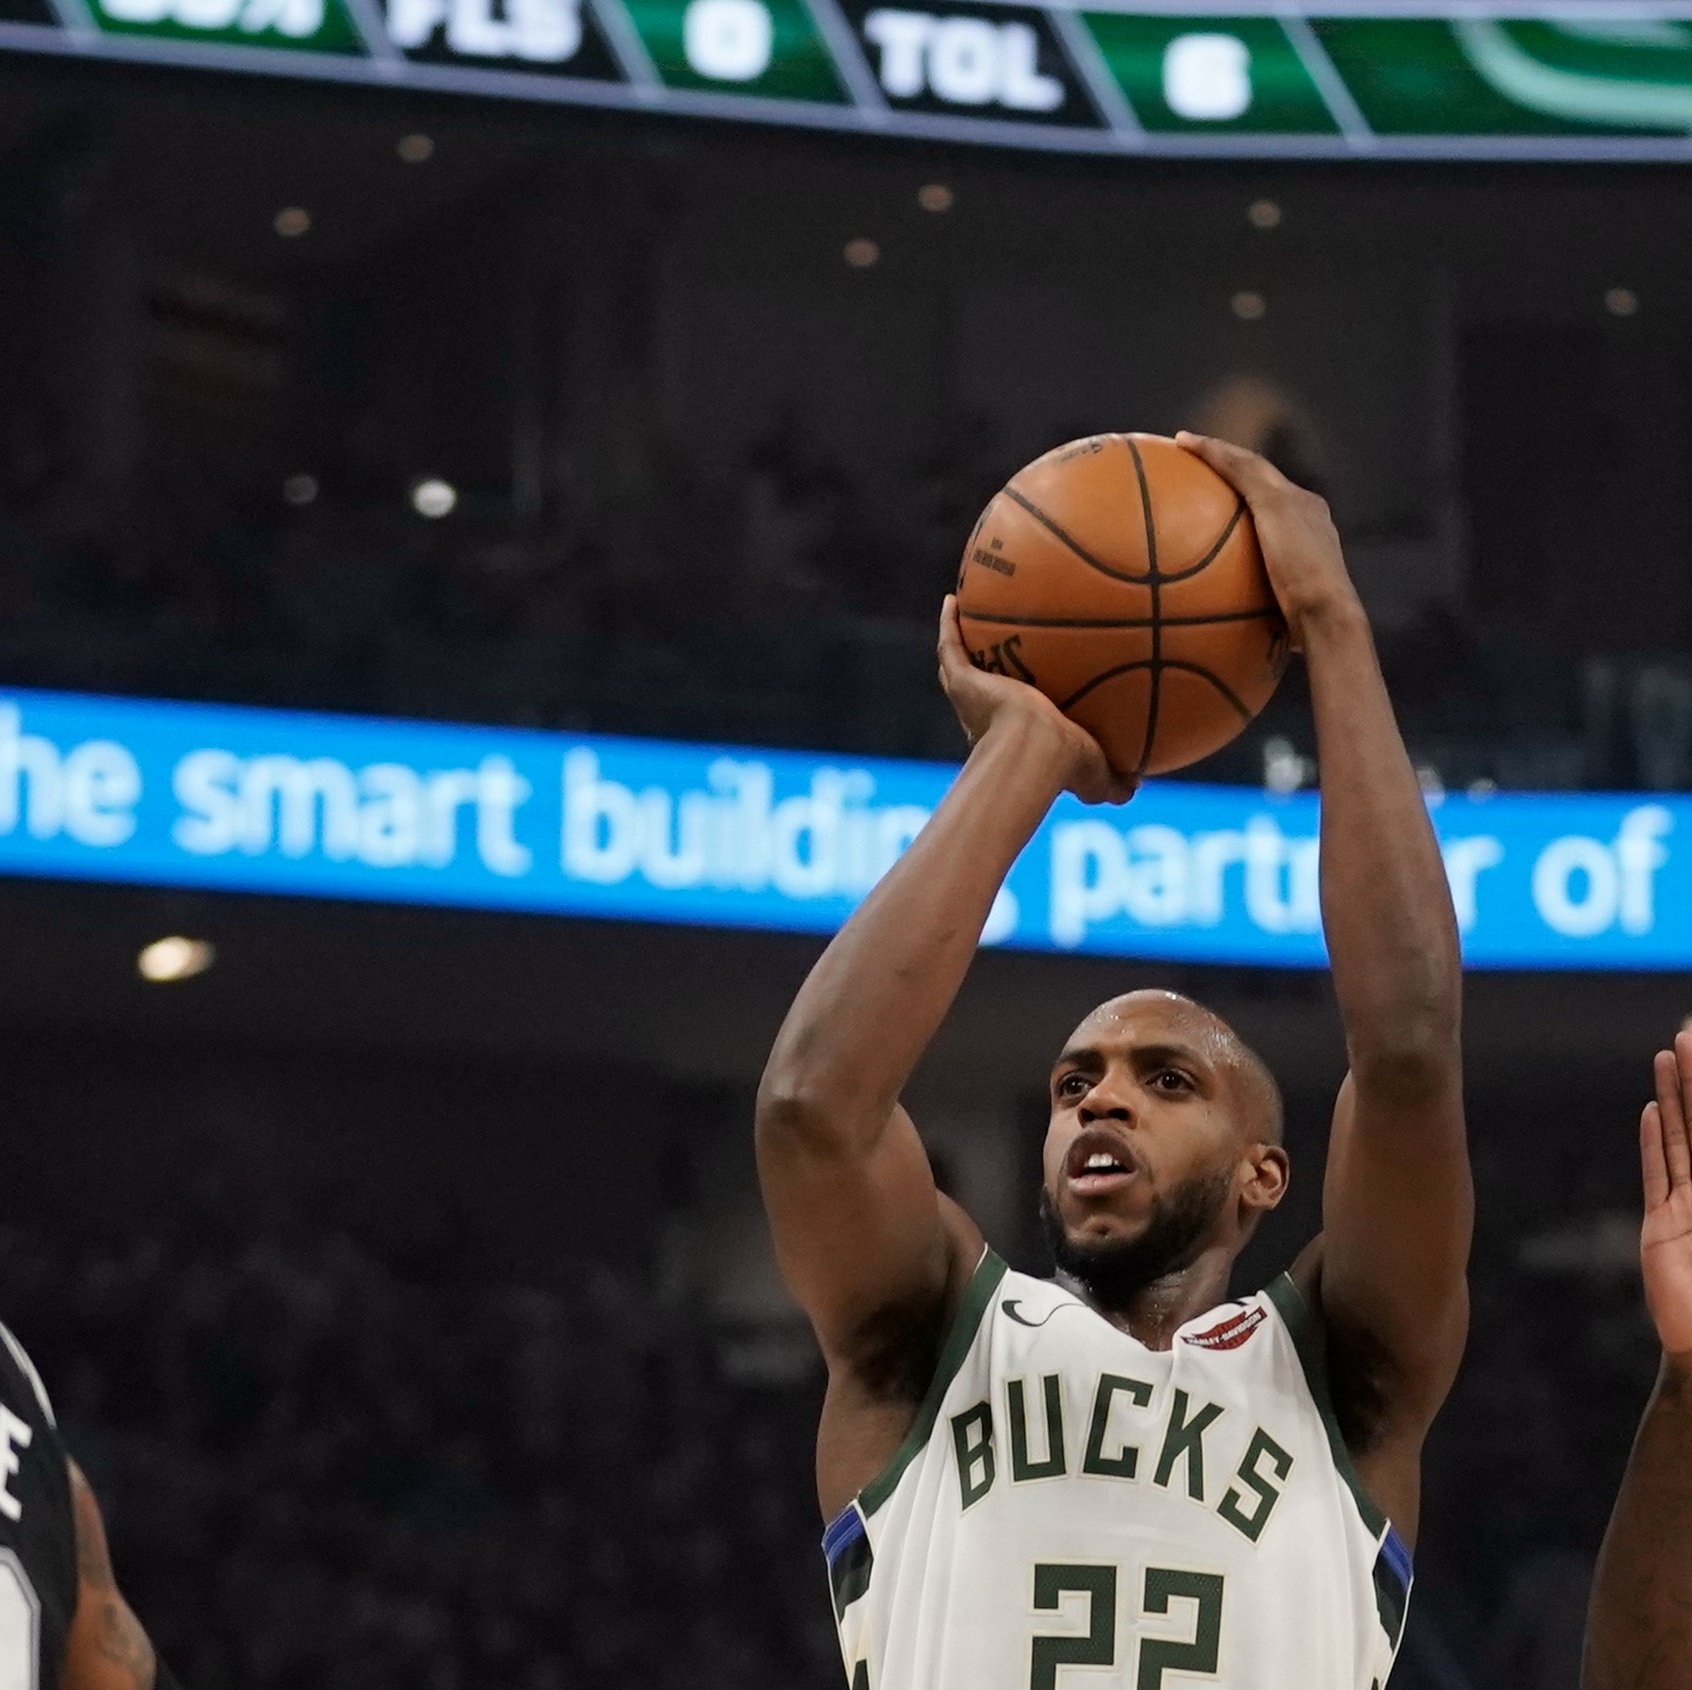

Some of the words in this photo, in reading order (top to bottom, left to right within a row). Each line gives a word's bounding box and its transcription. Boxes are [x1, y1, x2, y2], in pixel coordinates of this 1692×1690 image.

[864, 9, 1065, 111] TOL
[1162, 33, 1252, 121] 6
[171, 745, 532, 877] smart
[561, 744, 1020, 946] buildin
[1048, 804, 1505, 951] partr
[1530, 802, 1677, 936] of
[947, 1371, 1296, 1547] BUCKS
